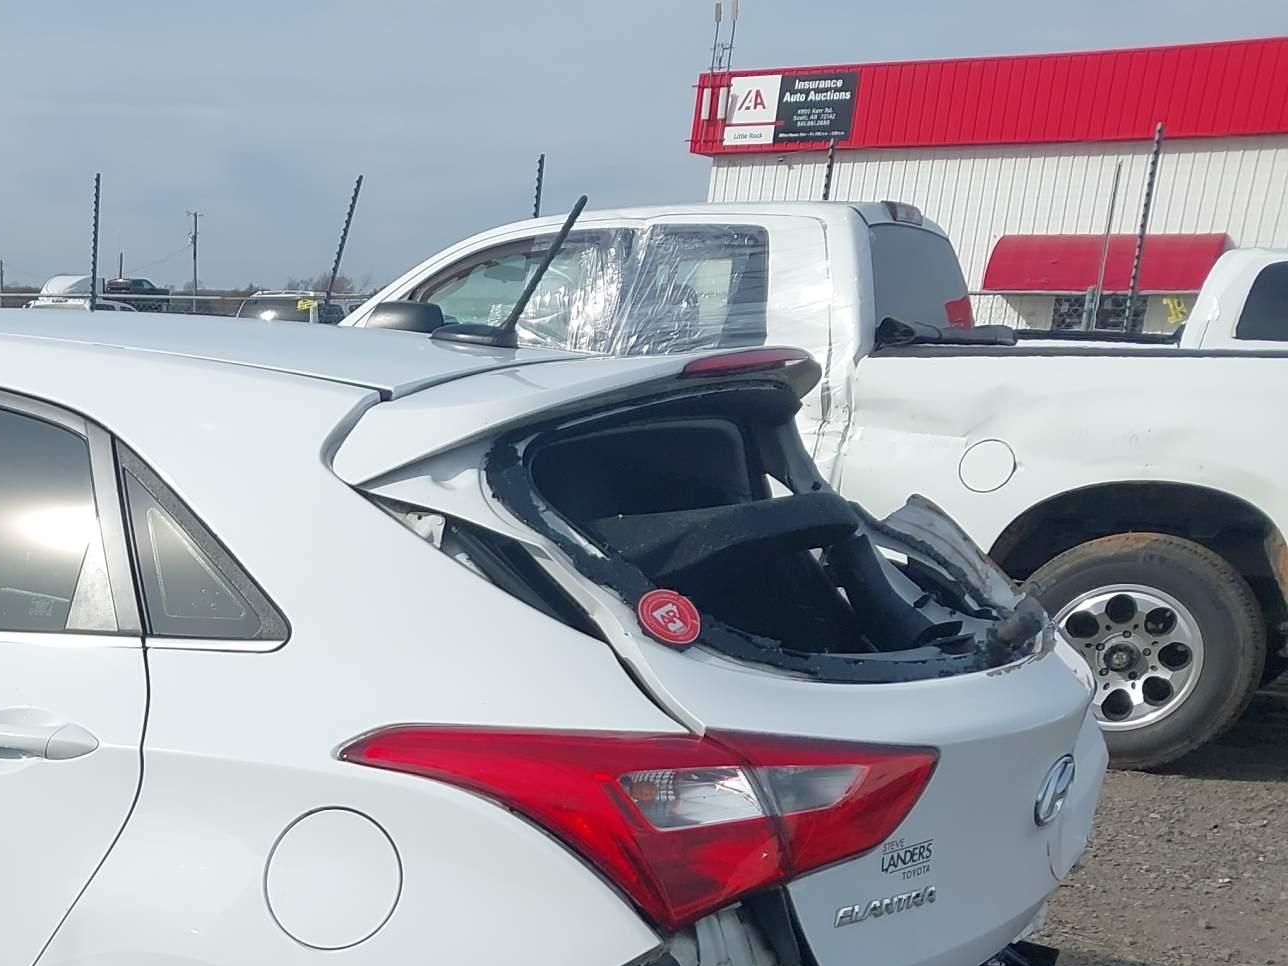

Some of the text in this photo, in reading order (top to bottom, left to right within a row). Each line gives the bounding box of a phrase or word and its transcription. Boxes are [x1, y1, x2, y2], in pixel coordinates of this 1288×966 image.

[794, 79, 843, 90] Insurance
[783, 89, 852, 103] Auto Auctions
[733, 131, 763, 140] Little Rock
[883, 838, 905, 852] STEVE
[881, 842, 933, 873] LANDERS
[902, 864, 931, 880] TOYOTA
[834, 885, 937, 929] ELANTRA
